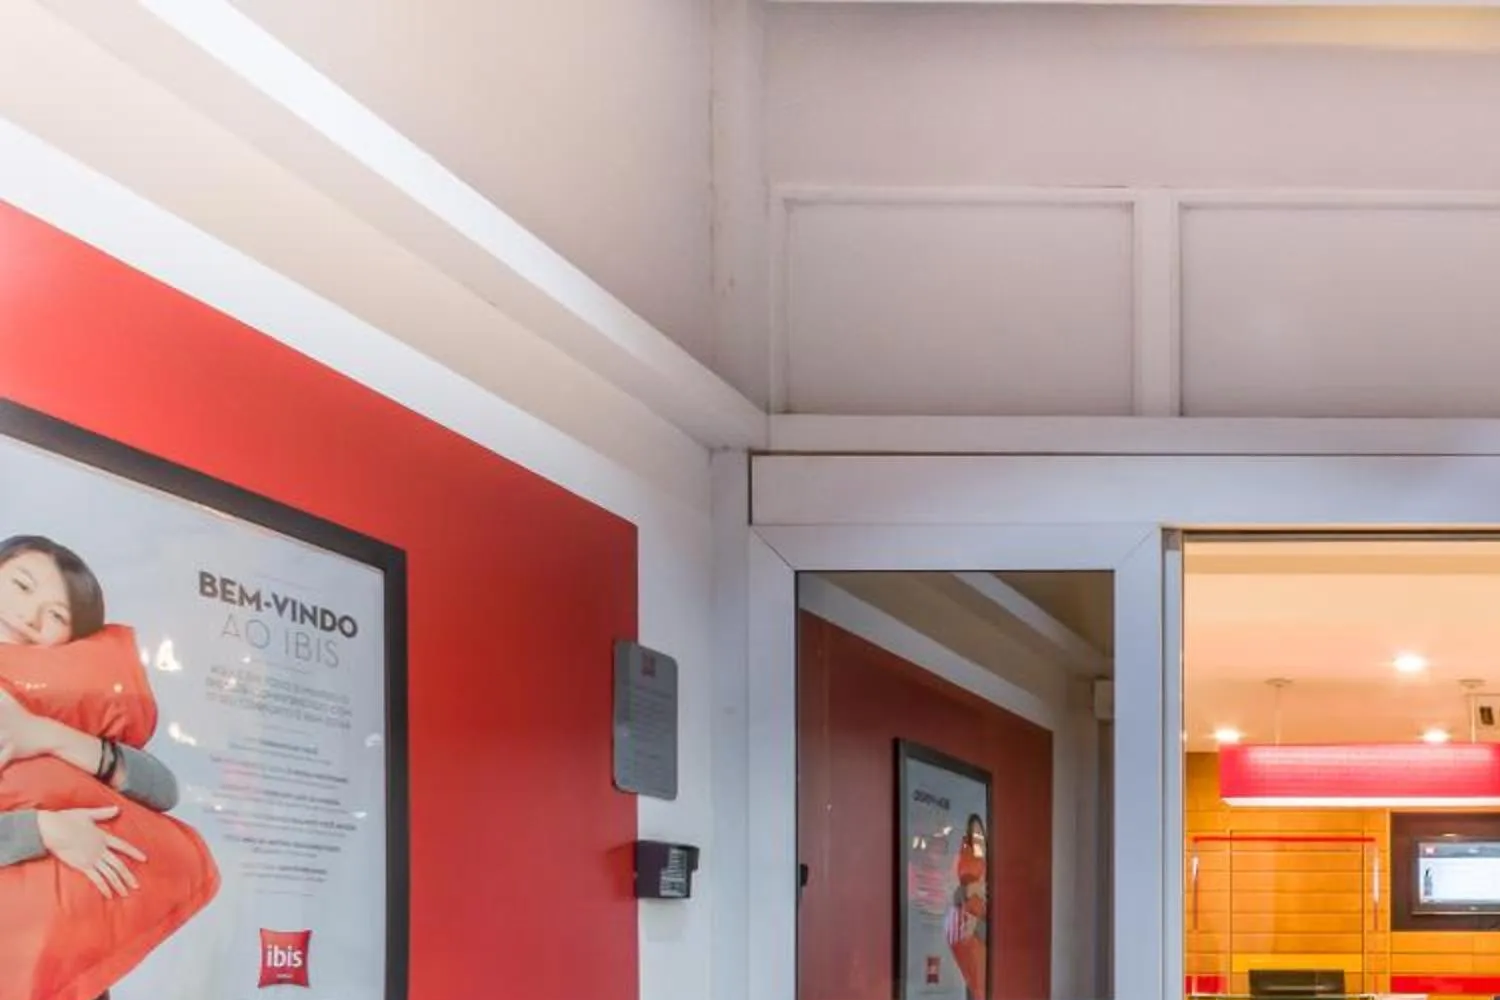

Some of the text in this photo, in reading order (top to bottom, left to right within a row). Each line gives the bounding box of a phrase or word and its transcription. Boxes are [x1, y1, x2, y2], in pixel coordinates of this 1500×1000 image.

[198, 571, 358, 639] BEM-VINDO
[220, 612, 340, 669] AO IBIS
[267, 944, 303, 968] ibis
